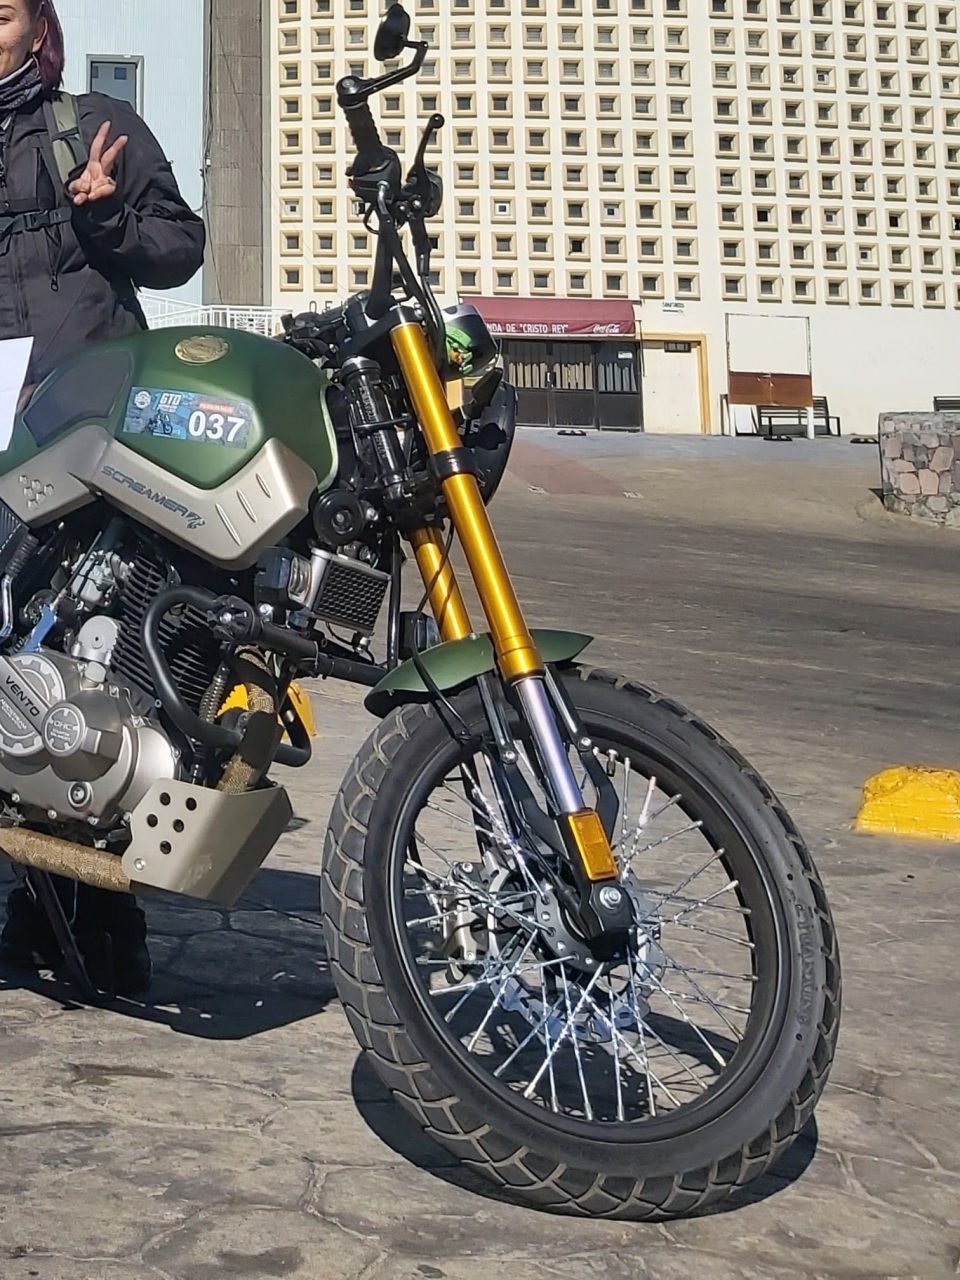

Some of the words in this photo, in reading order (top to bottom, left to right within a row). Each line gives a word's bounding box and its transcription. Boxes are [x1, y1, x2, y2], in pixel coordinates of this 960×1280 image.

[486, 324, 503, 333] NDA
[506, 324, 516, 333] DE
[189, 411, 245, 442] 037
[101, 465, 189, 517] SCREAMER
[6, 675, 40, 717] VENTO
